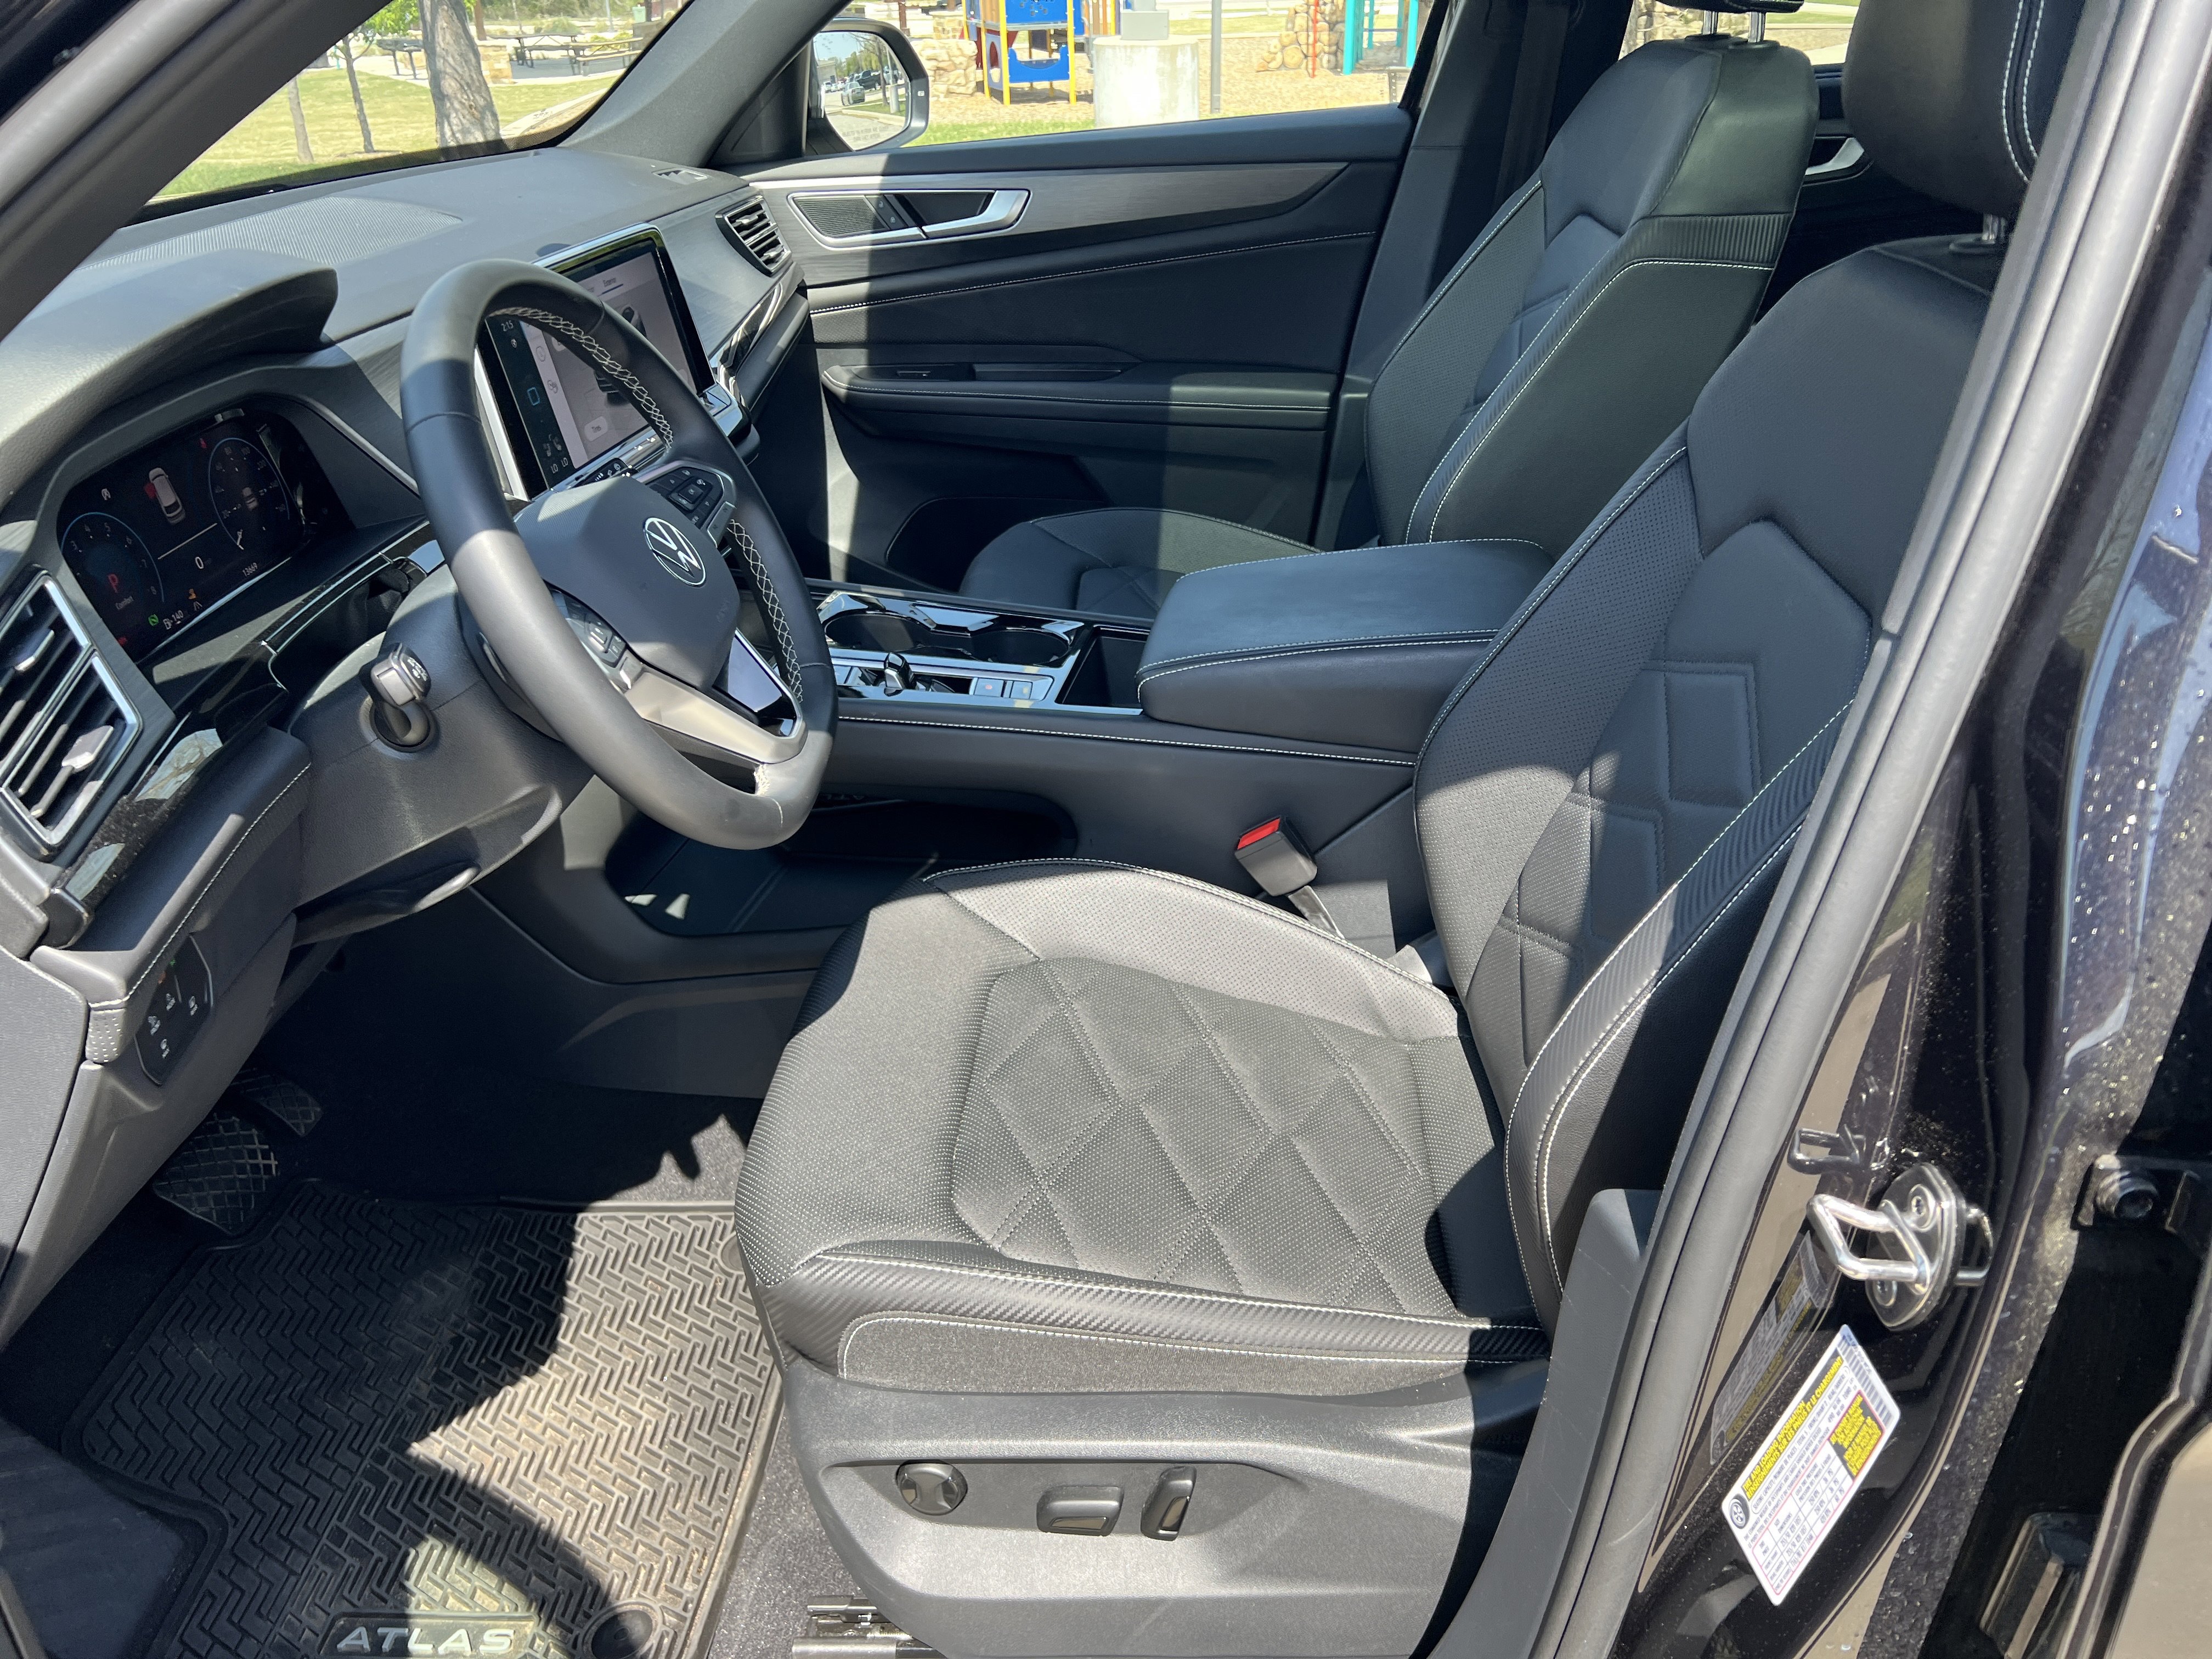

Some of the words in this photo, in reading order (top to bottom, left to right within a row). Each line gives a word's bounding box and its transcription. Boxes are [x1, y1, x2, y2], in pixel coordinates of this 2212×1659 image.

[108, 573, 119, 593] P
[1742, 1477, 1752, 1493] TIRE
[1750, 1464, 1761, 1482] AND
[1759, 1438, 1779, 1468] LOADING
[1776, 1399, 1805, 1442] INFORMATION
[1746, 1448, 1780, 1500] RENSEIGNEMENTS
[1778, 1435, 1789, 1453] SUR
[1786, 1426, 1795, 1440] LES
[1792, 1407, 1808, 1431] PNEUS
[1814, 1355, 1843, 1398] CHARGEMENT
[337, 1626, 516, 1655] ATLAS
